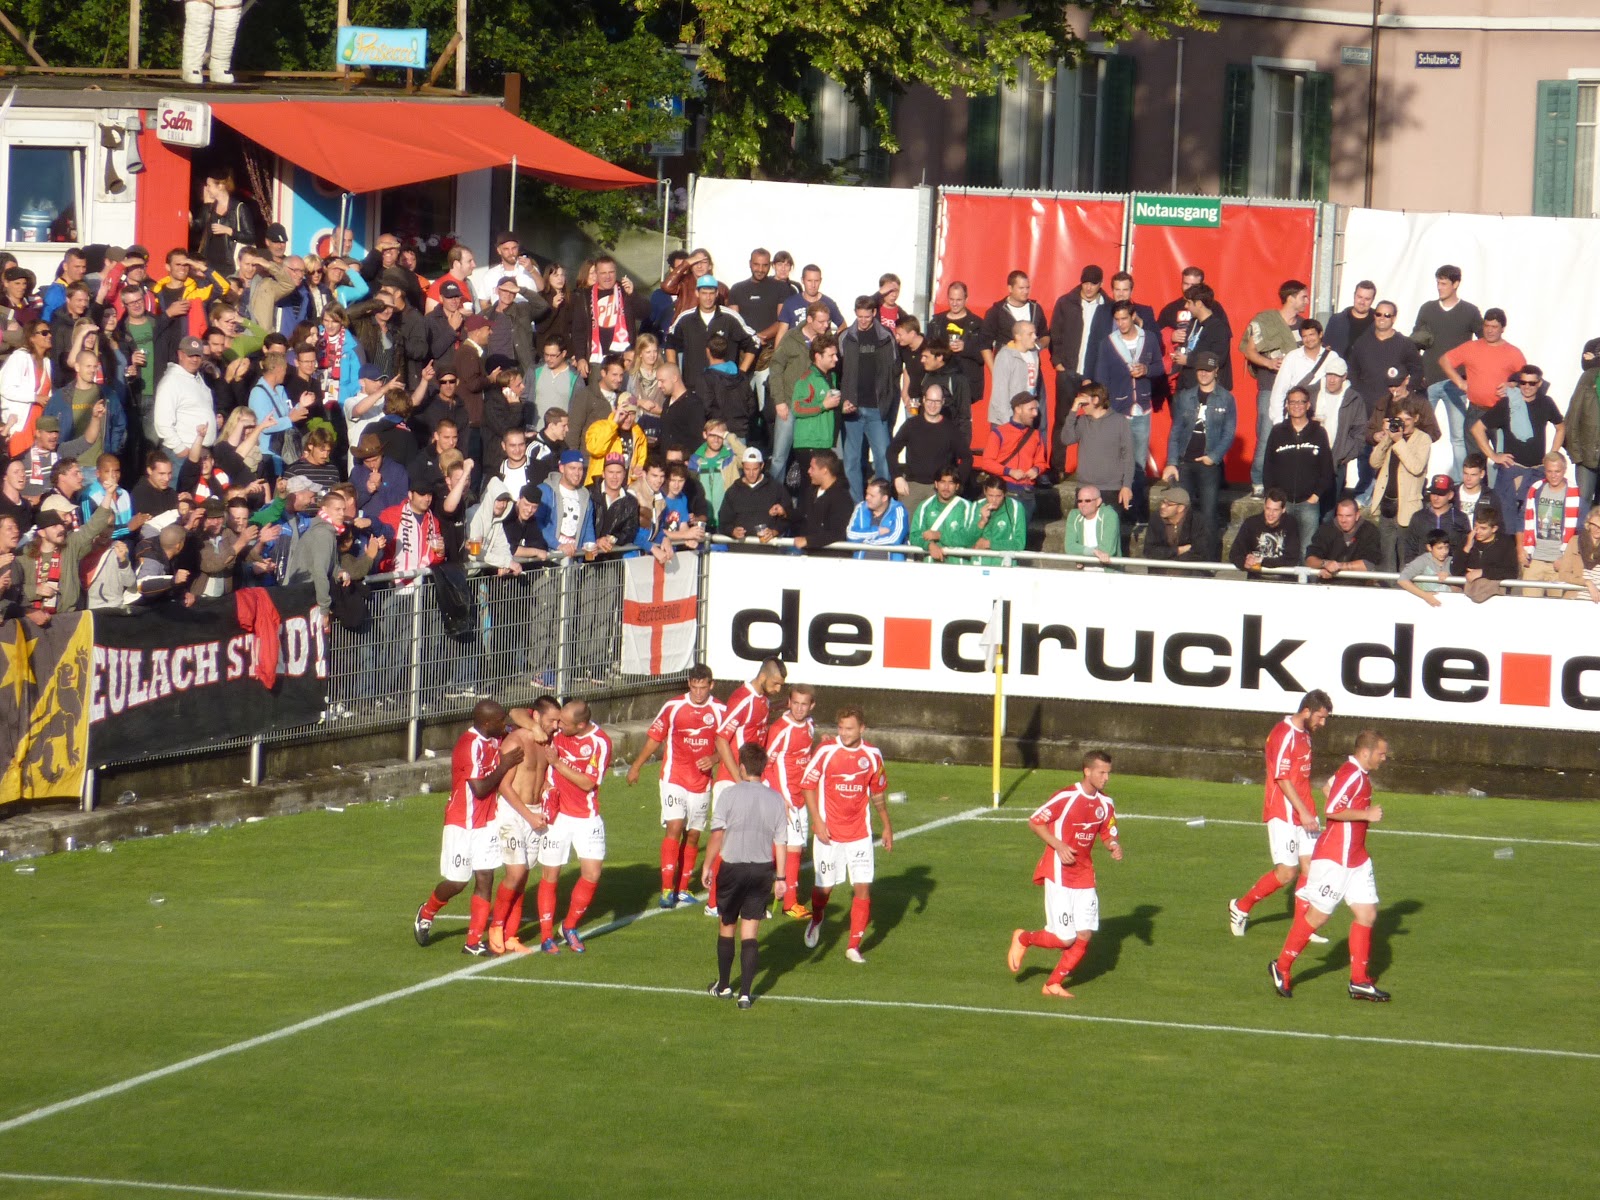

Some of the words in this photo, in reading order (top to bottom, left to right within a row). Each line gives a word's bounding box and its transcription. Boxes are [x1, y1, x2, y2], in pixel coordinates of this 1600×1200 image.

[160, 109, 193, 131] Salon
[1136, 202, 1219, 222] Notausgang
[89, 640, 221, 724] EULACH
[226, 604, 330, 681] STDT
[683, 736, 709, 746] KELLER
[835, 783, 863, 793] KELLER
